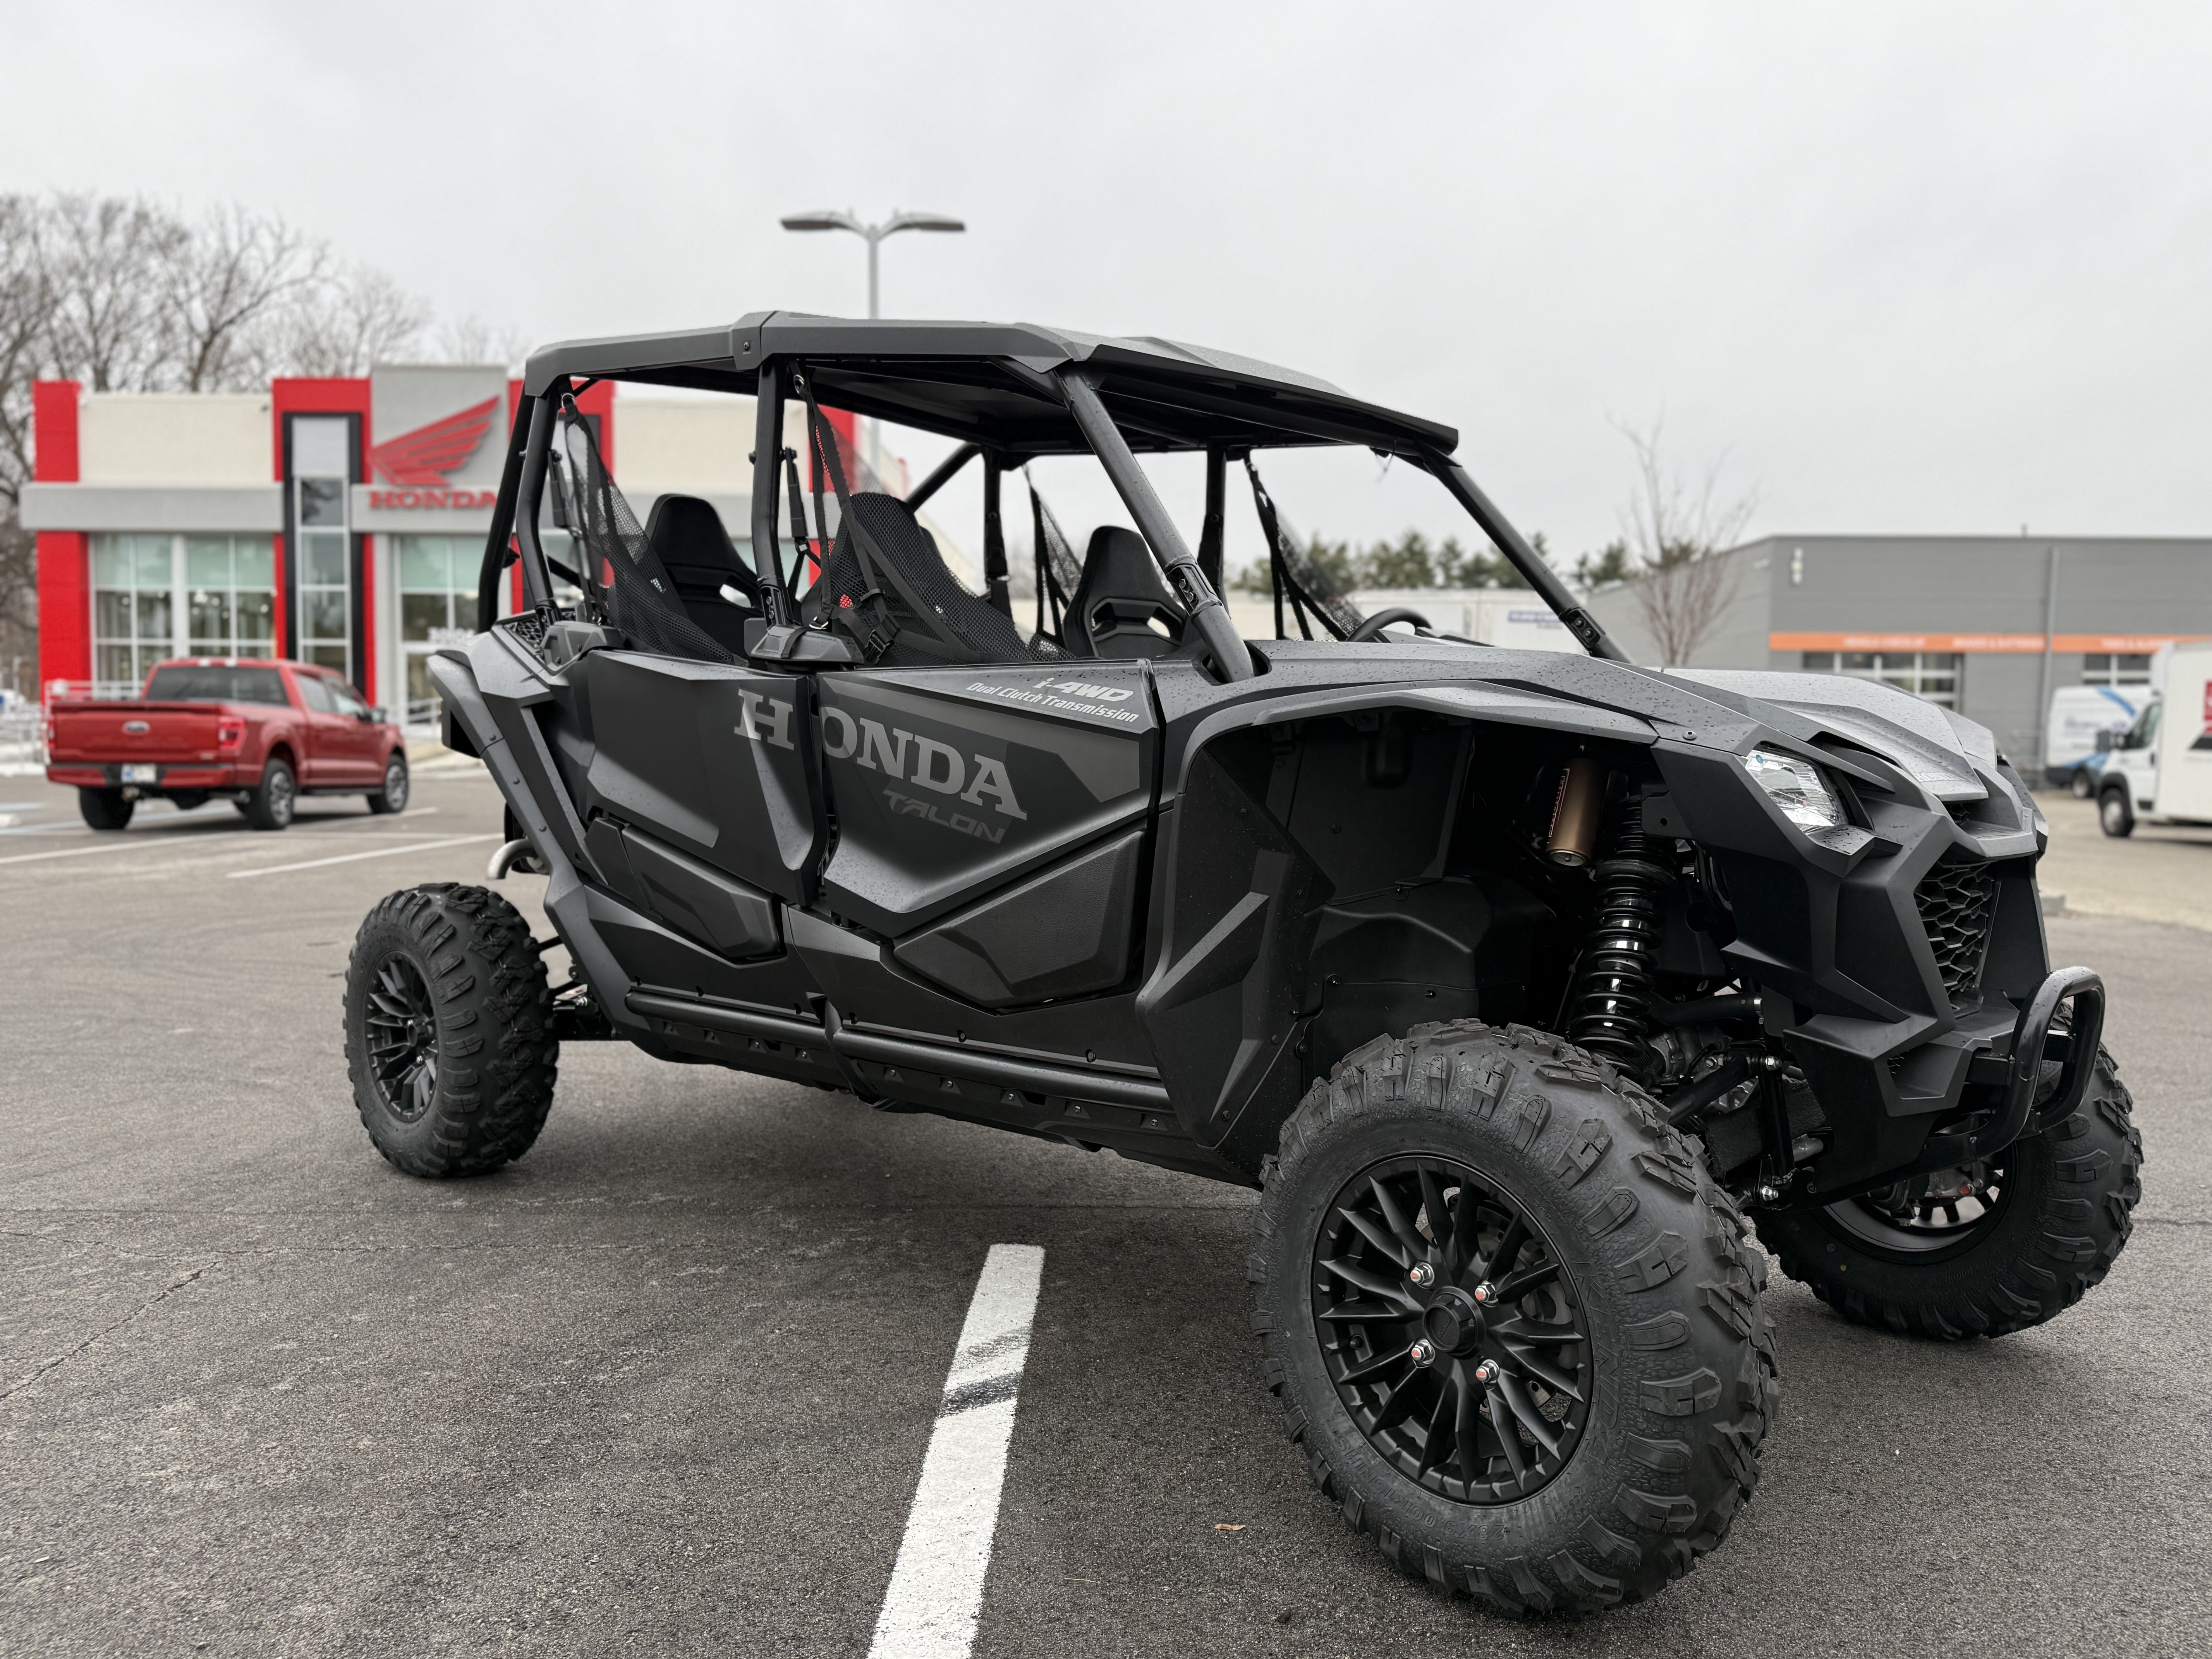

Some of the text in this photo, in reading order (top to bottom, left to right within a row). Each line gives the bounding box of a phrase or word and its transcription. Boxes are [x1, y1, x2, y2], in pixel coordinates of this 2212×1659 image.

[369, 491, 498, 508] HONDA
[965, 682, 1139, 722] Dual Clutch Transmission
[1032, 677, 1134, 701] i-4WD
[734, 688, 1028, 821] HONDA
[882, 788, 1005, 844] TALON
[1571, 1261, 1620, 1466] KENDA
